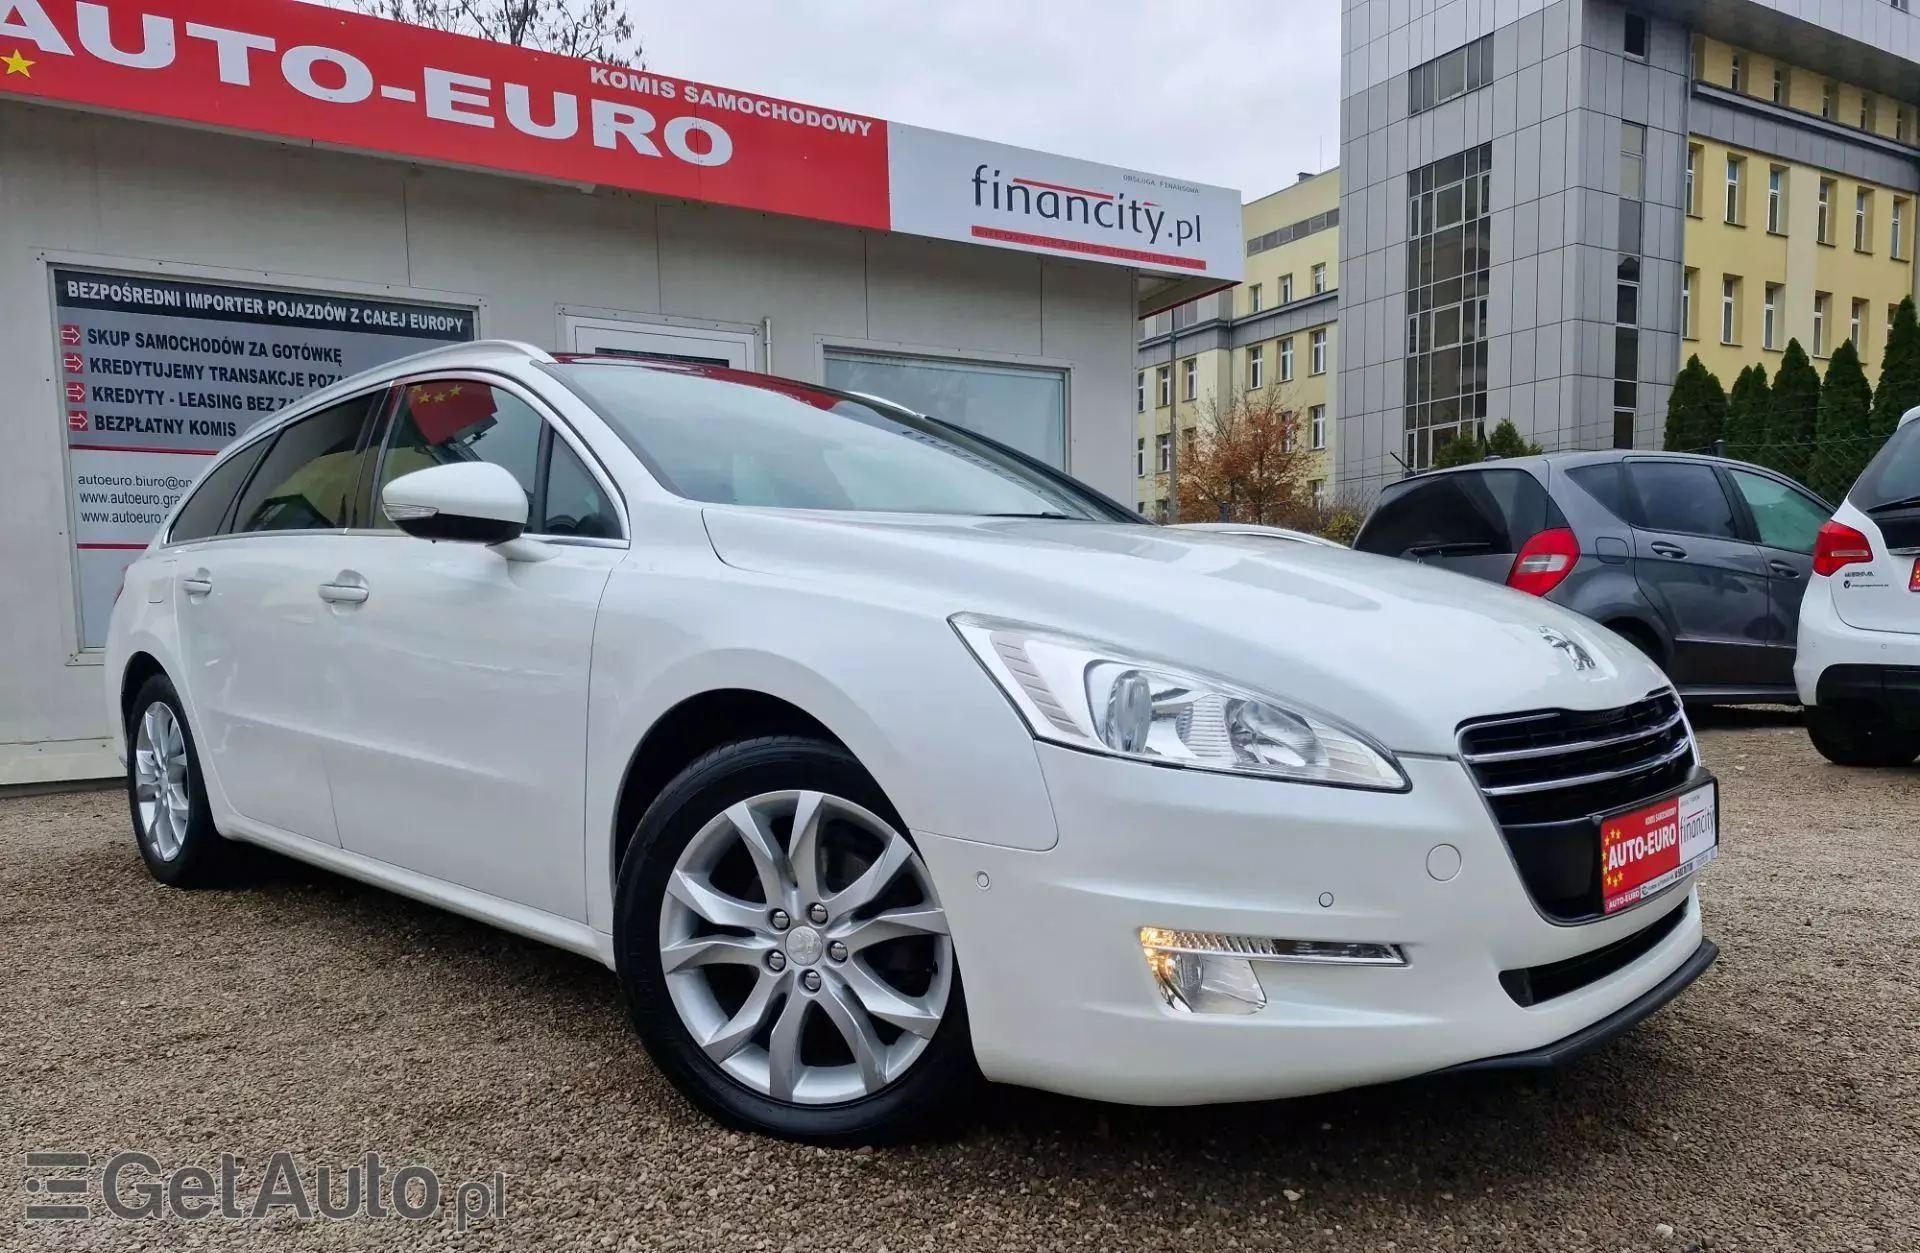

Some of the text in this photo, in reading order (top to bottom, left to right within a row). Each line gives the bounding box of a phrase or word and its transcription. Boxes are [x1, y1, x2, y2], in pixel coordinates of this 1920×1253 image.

[0, 0, 733, 166] AUTO-EURO
[590, 66, 872, 137] KOMIS SAMOCHODOWY
[971, 164, 1201, 247] financity.pl
[67, 280, 464, 333] BEZPOŚREDNI IMPORTER POJAZDÓW Z CAŁEJ EUROPY
[87, 328, 343, 368] SKUP SAMOCHODÓW ZA GOTÓWKĘ
[89, 357, 349, 389] KREDYTUJEMY TRANSAKCJE POZ
[92, 386, 165, 406] KREDYTY
[178, 391, 242, 410] LEASING
[246, 396, 275, 413] BEZ
[94, 414, 237, 437] BEZPŁATNY KOMIS
[80, 491, 184, 509] www.autoeuro.gra
[1680, 804, 1715, 845] financity
[1608, 823, 1676, 871] AUTO-EURO
[1608, 890, 1641, 910] AUTO-EURO
